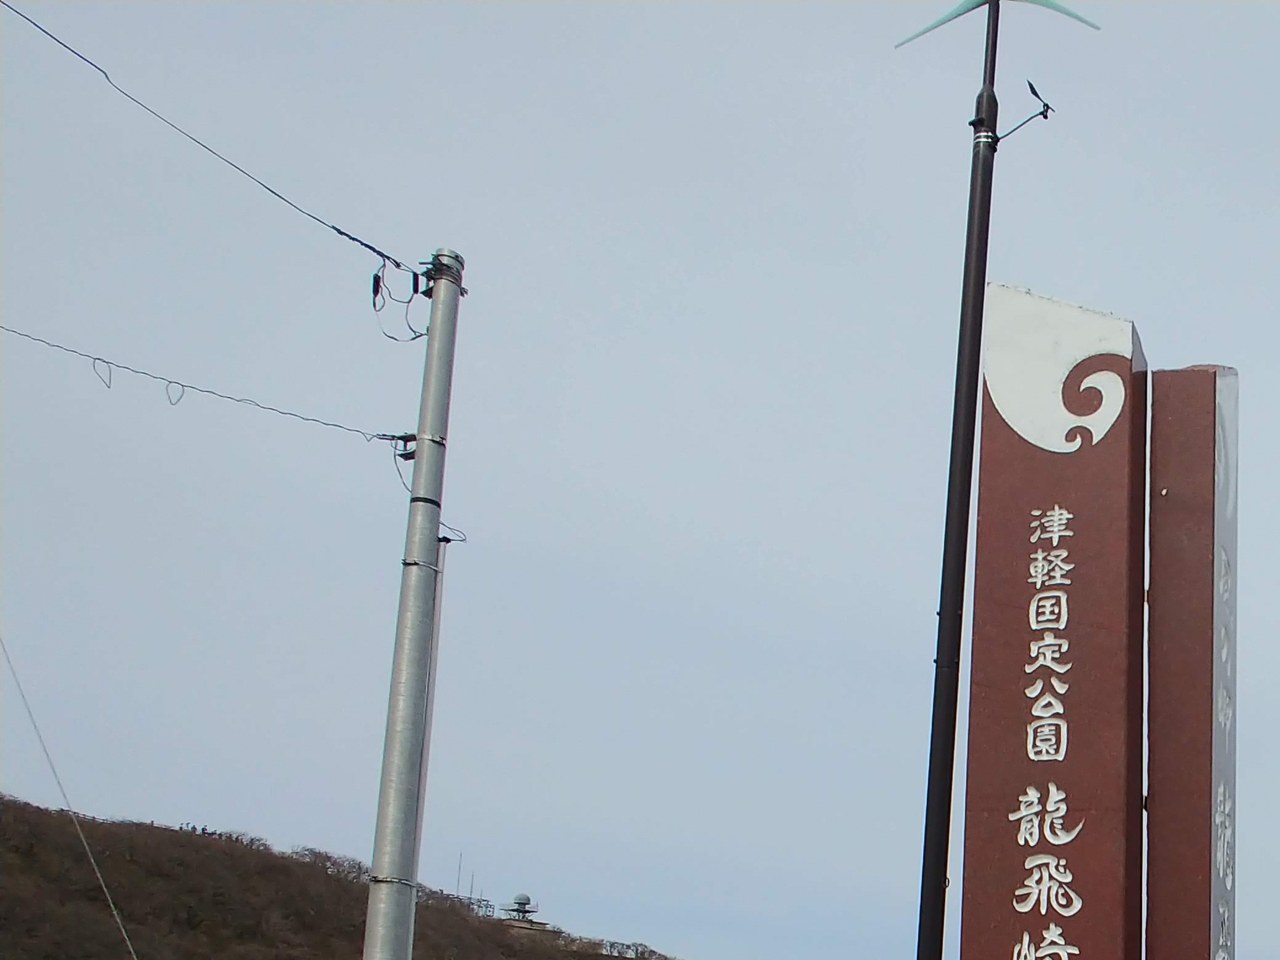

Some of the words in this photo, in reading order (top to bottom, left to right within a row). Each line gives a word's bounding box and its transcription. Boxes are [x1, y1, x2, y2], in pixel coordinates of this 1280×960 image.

[1025, 504, 1075, 763] 津軽国定公園
